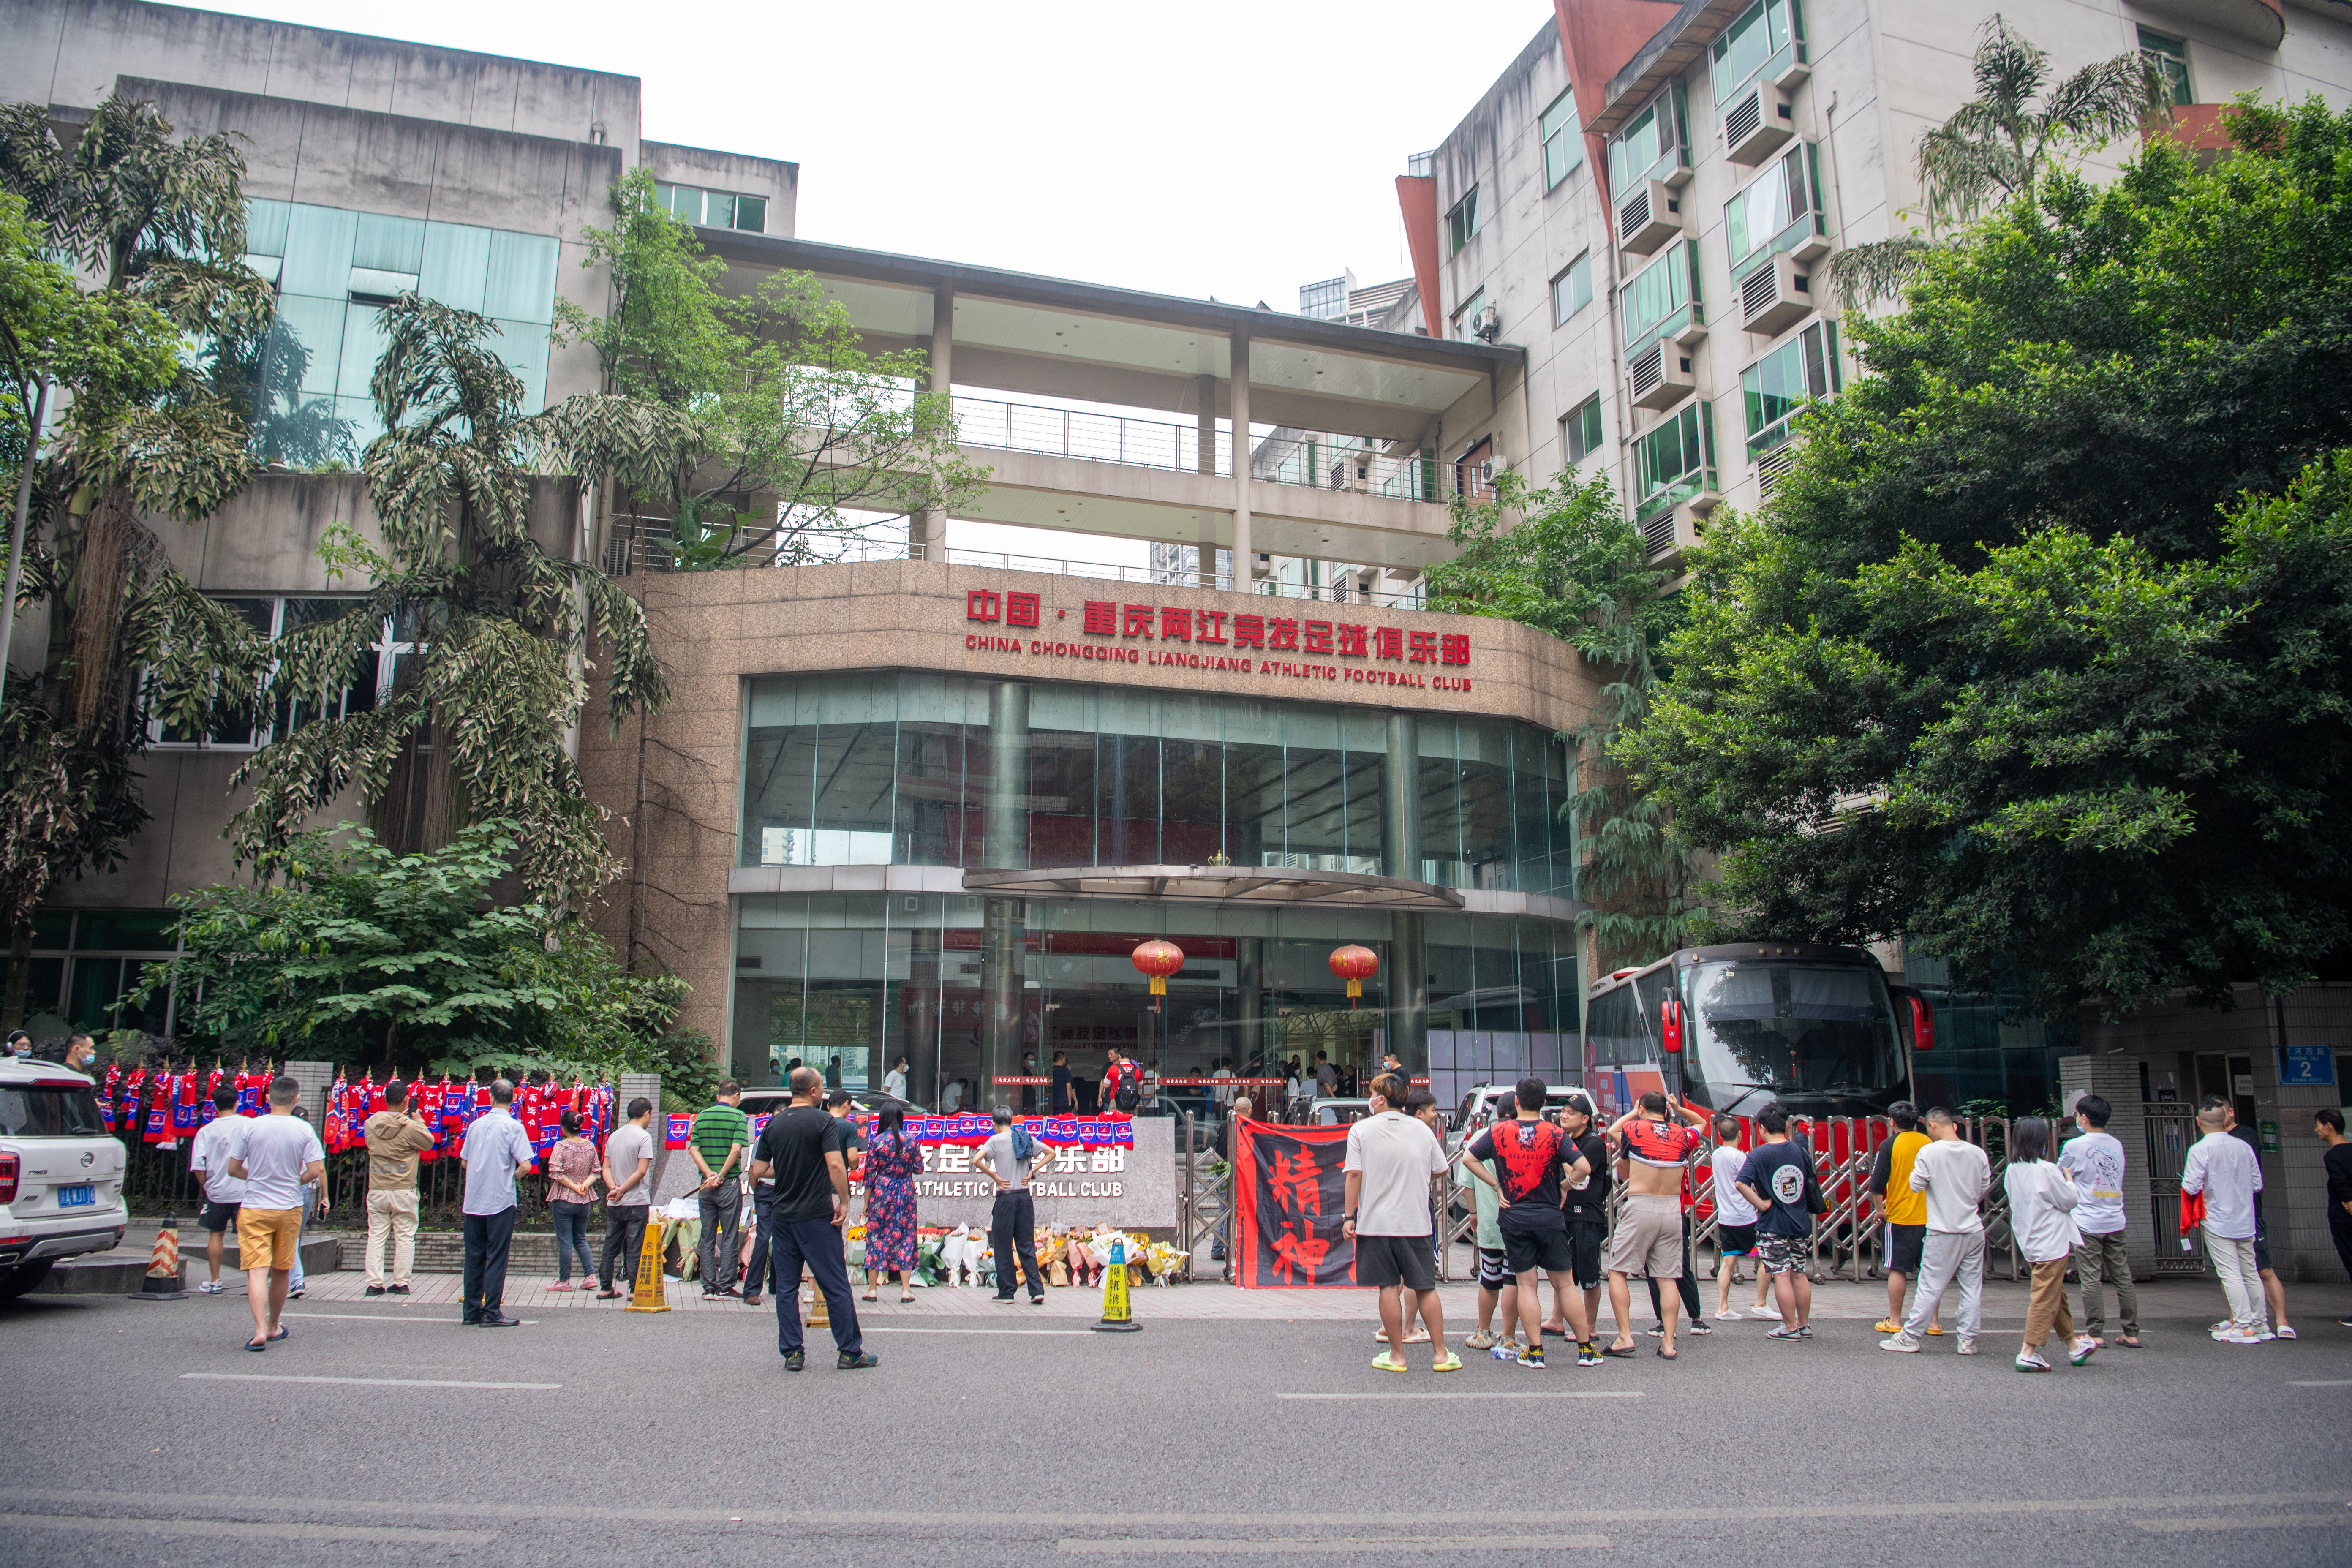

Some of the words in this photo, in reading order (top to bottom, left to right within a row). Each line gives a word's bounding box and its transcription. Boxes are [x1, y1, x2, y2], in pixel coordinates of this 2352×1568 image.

[966, 635, 1021, 652] CHINA
[1031, 640, 1139, 662] CHONGQING
[1149, 651, 1251, 671] LIANGJIANG
[1260, 661, 1336, 679] ATHLETIC
[1345, 668, 1425, 686] FOOTBALL
[1433, 676, 1472, 690] CLUB
[2301, 1061, 2311, 1077] 2
[2092, 1143, 2111, 1154] YEAR
[1784, 1168, 1802, 1181] STIRRED
[1080, 1181, 1122, 1197] CLUB
[1267, 1144, 1330, 1286] 精神
[638, 1255, 647, 1285] 做幸福男人
[644, 1255, 653, 1285] 到宝莱医院
